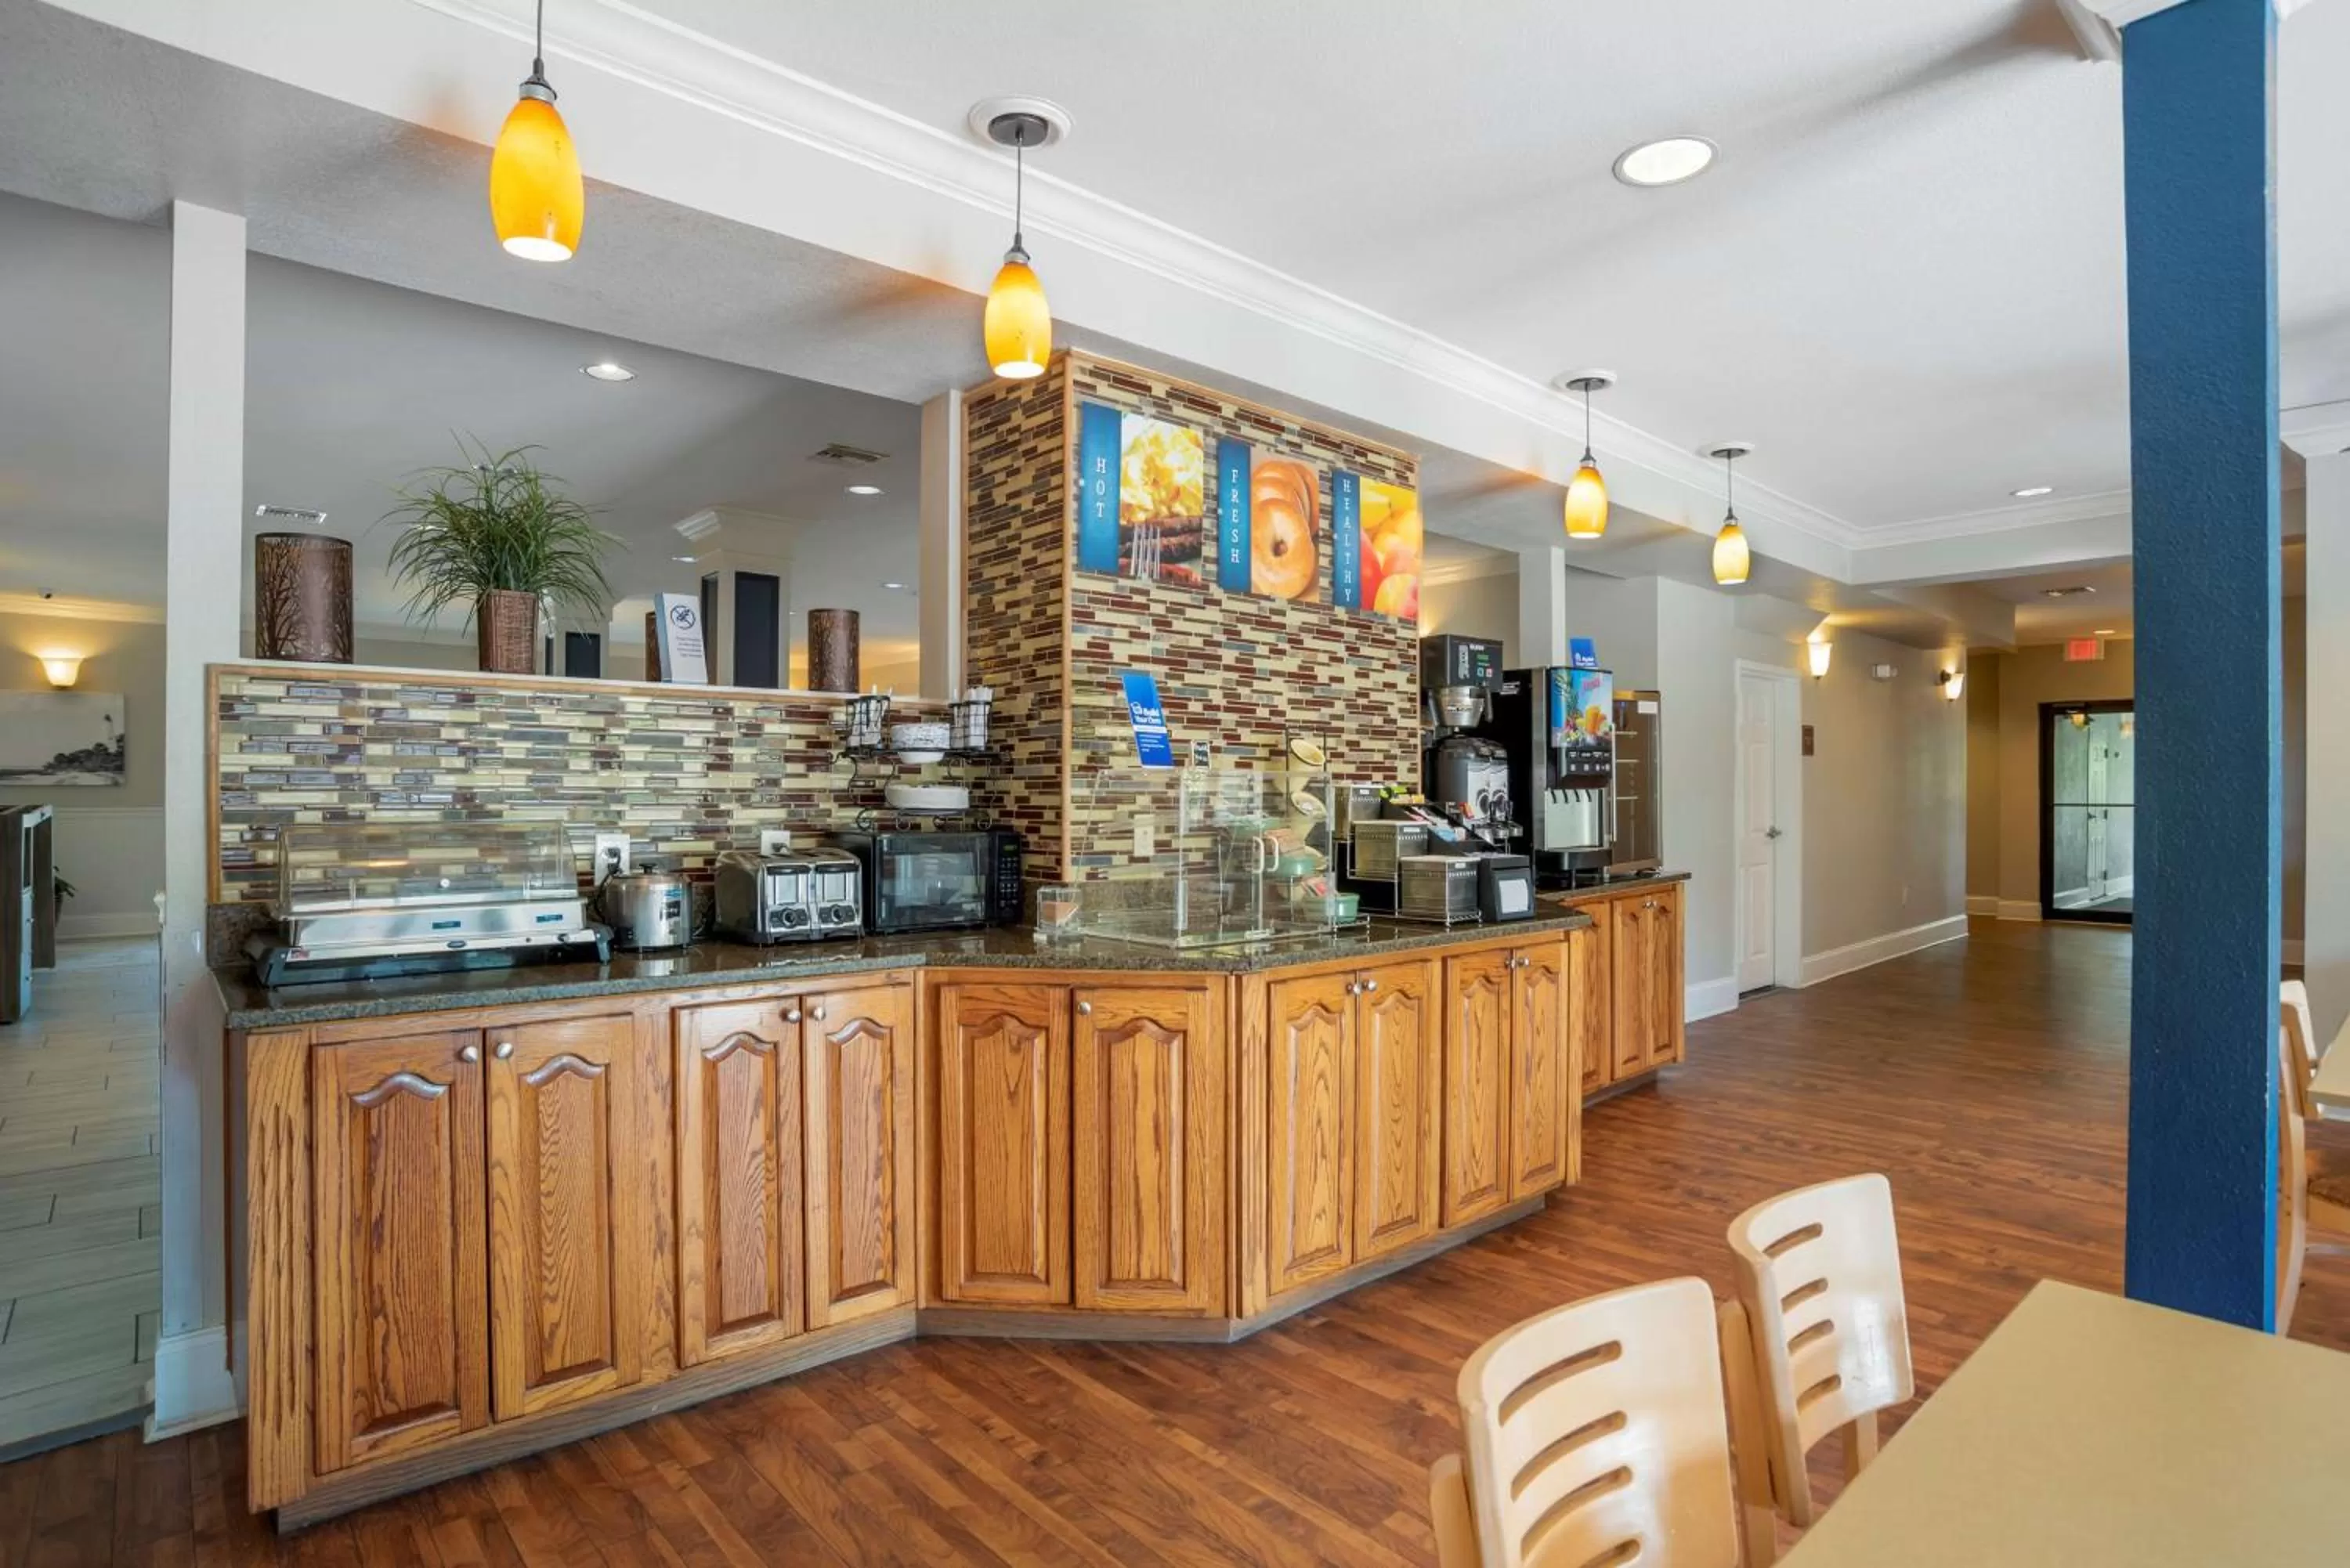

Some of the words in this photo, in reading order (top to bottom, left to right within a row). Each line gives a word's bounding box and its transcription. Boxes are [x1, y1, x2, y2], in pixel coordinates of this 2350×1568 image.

[1096, 457, 1106, 518] HOT
[1231, 469, 1239, 564] FRESH
[1343, 479, 1351, 602] HEALTHY
